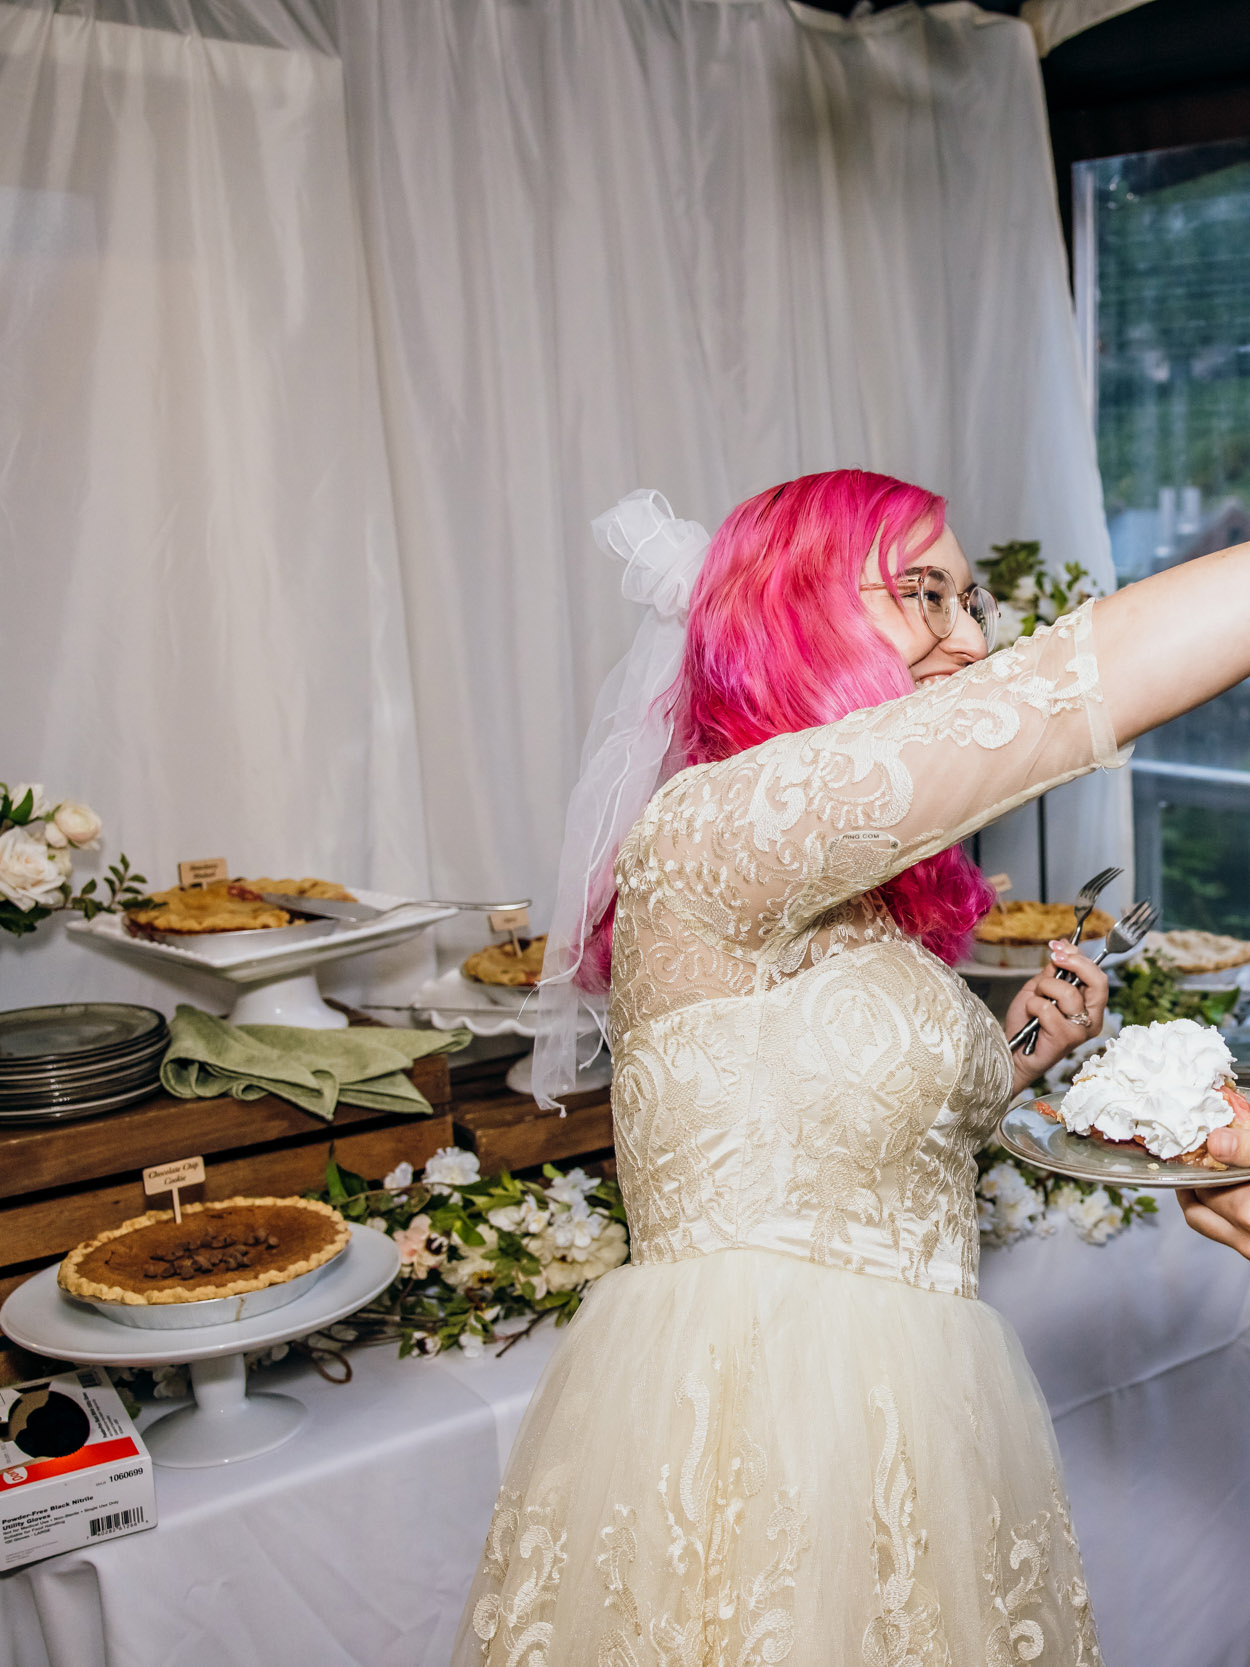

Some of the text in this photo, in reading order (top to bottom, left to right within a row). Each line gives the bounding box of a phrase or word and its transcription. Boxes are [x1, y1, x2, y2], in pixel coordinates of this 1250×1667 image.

[109, 1467, 144, 1482] 1060699
[2, 1496, 94, 1525] Powder-Free Black Nitrile
[2, 1514, 51, 1531] Utility Gloves
